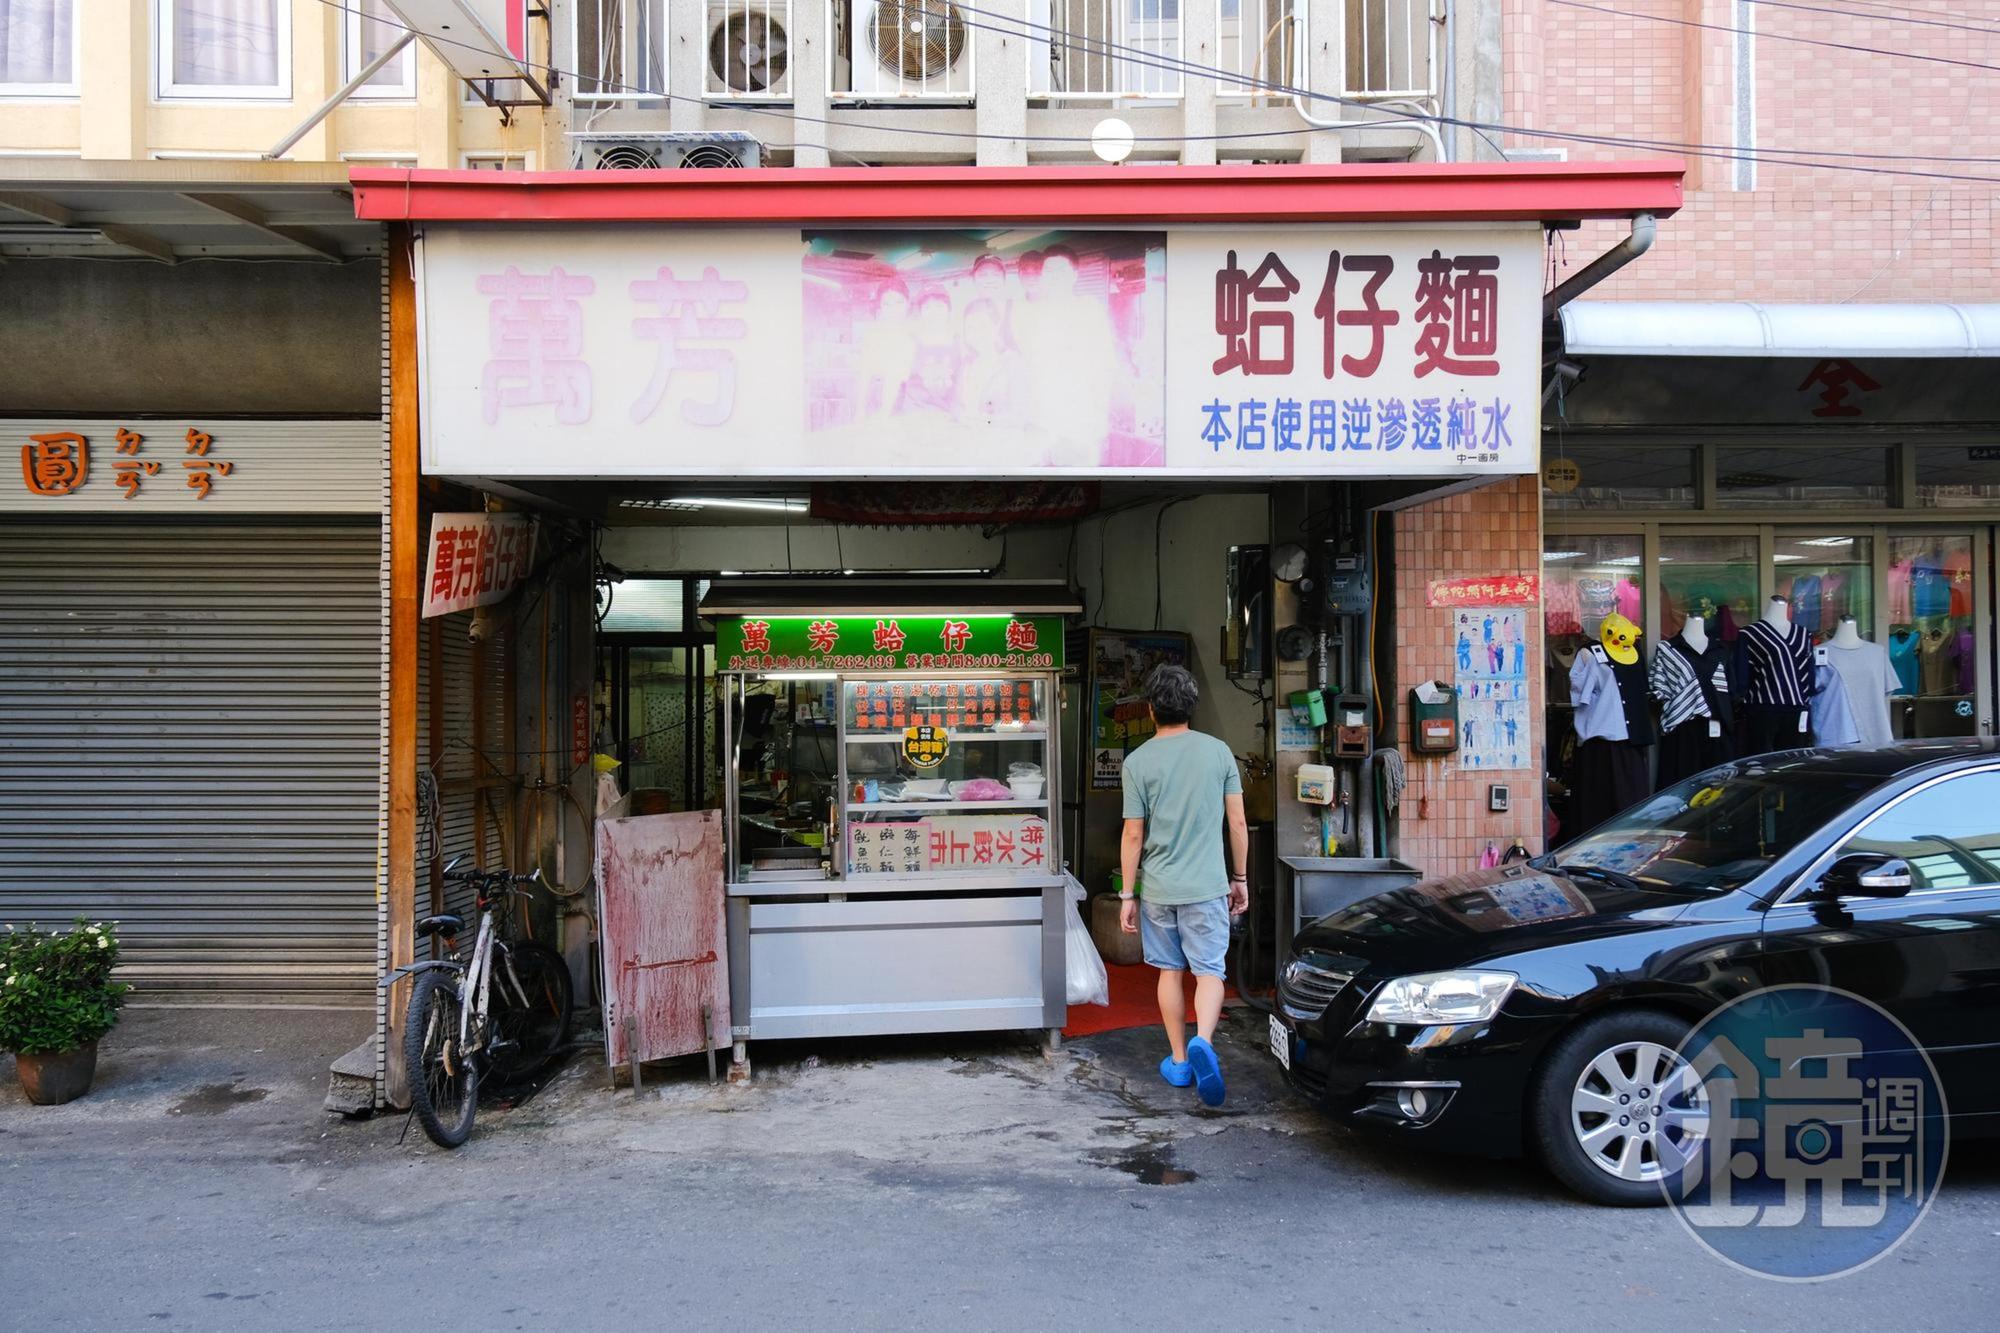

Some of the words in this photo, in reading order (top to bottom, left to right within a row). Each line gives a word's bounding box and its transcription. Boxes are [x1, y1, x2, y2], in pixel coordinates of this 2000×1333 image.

[475, 264, 748, 427] 萬芳
[1212, 248, 1500, 379] 蛤仔麵
[1201, 397, 1512, 452] 本店使用逆滲透純水
[740, 619, 1039, 653] 萬芳蛤仔麵
[908, 741, 943, 753] 台灣豬
